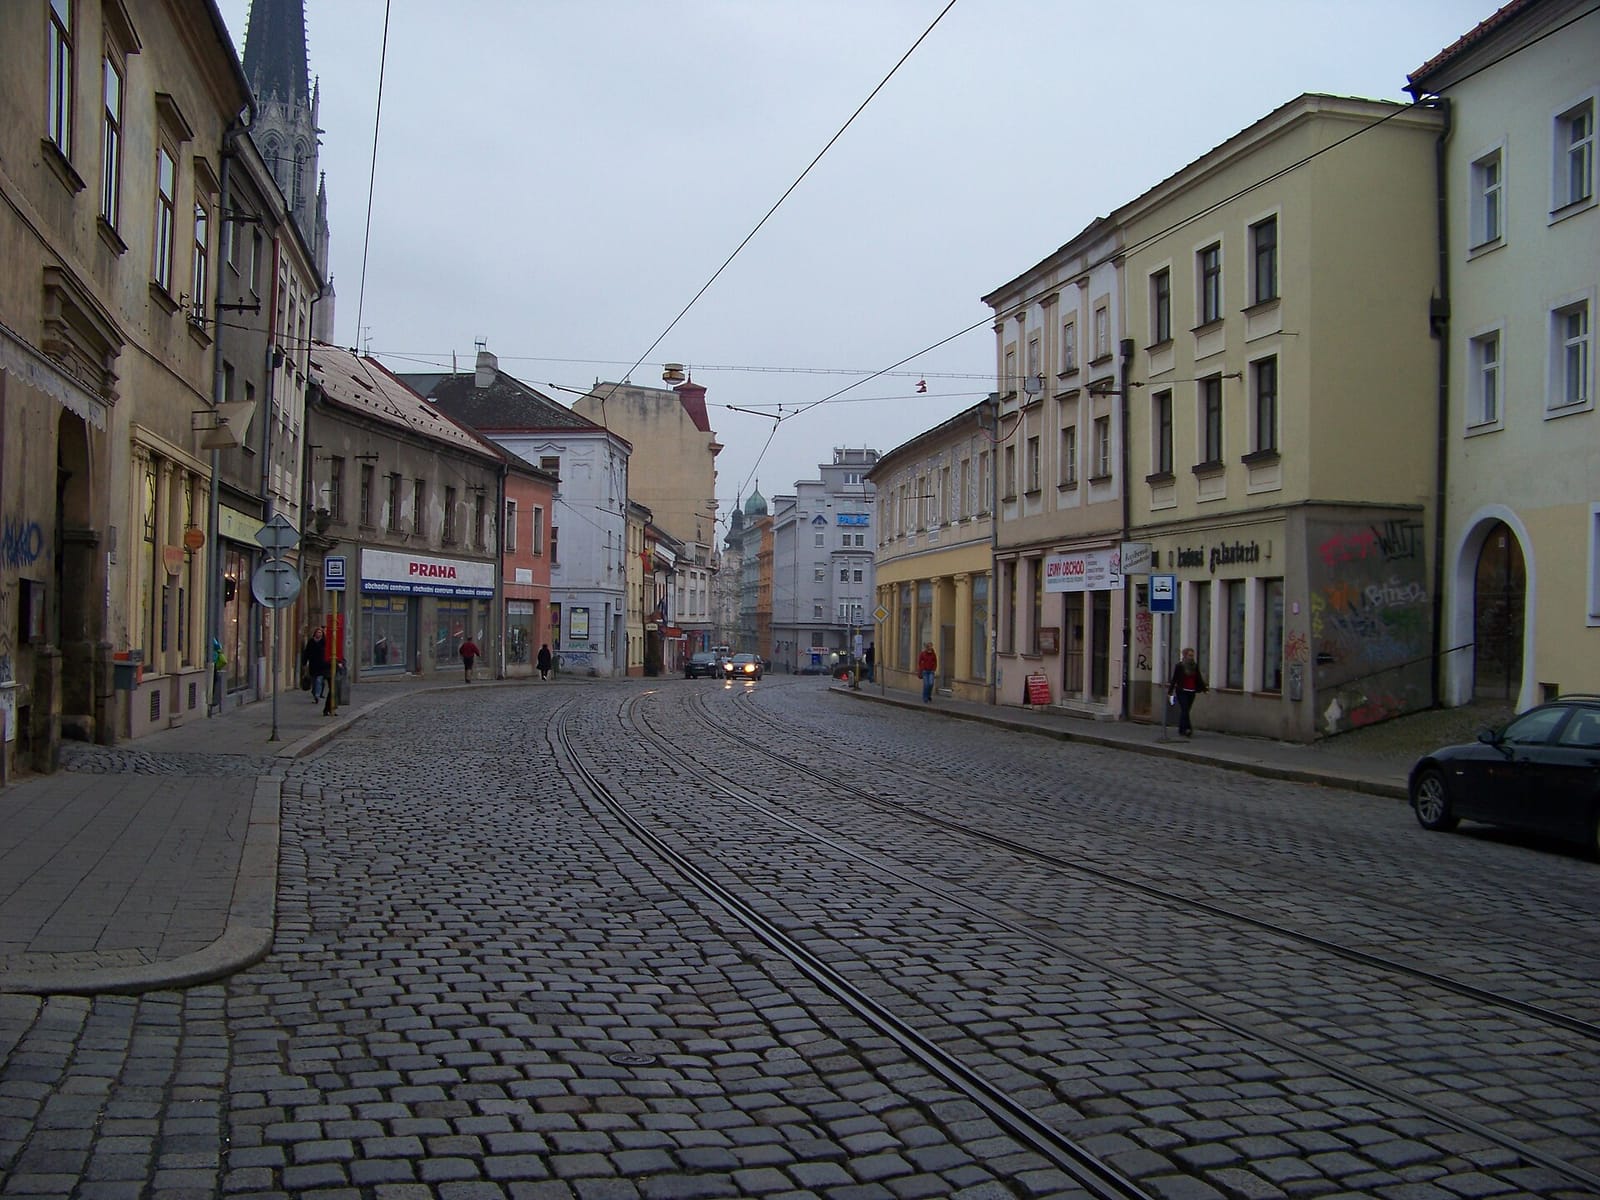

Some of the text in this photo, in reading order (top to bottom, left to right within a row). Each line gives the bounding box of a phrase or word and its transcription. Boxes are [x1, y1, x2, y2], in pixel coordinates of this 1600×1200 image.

[409, 562, 457, 579] PRAHA
[1062, 560, 1085, 576] OBCHOD
[390, 583, 411, 592] centrum
[434, 586, 454, 594] centrum
